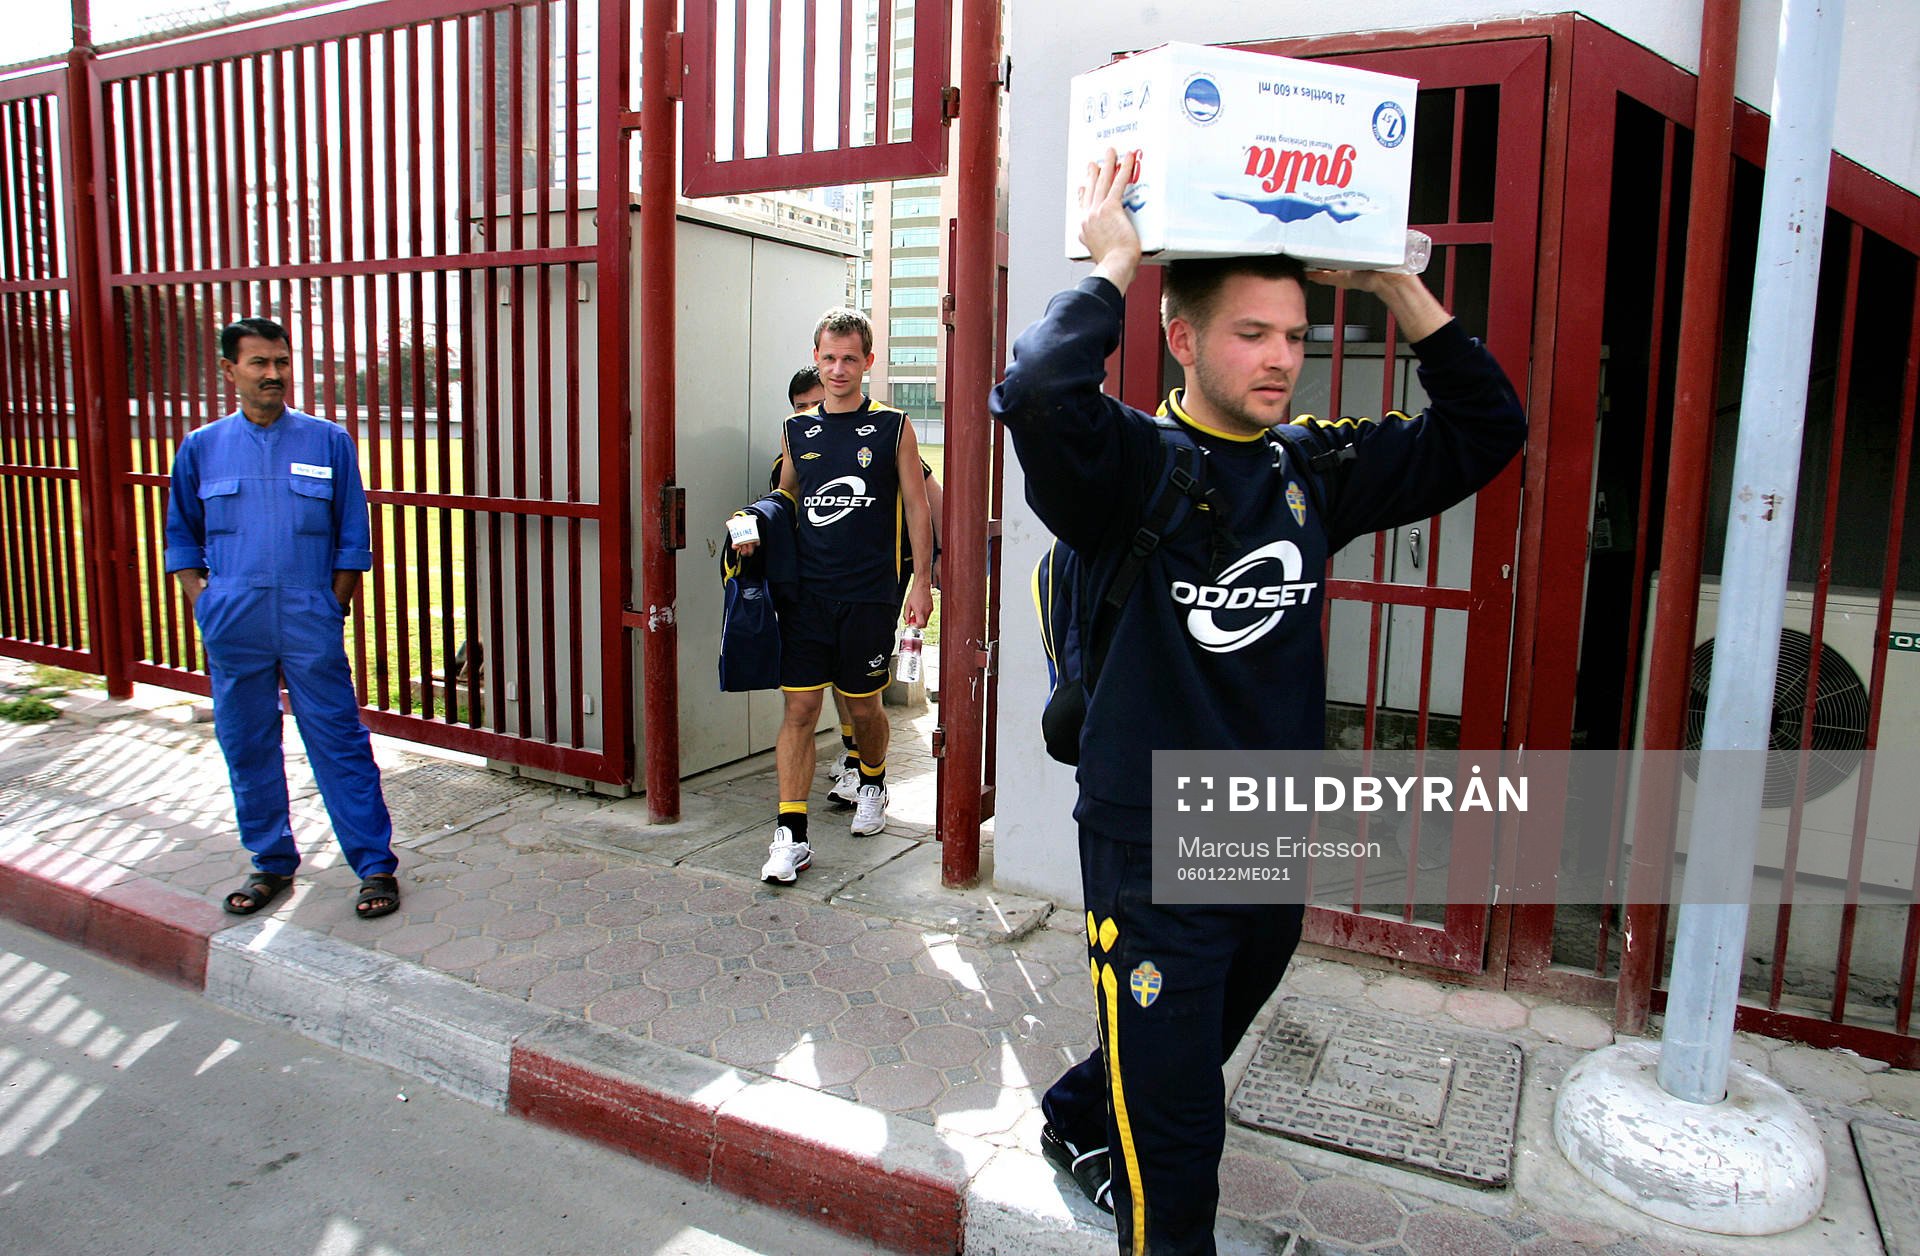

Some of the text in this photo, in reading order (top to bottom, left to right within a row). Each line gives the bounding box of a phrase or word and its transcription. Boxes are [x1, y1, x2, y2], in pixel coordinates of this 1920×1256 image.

[1258, 81, 1345, 105] 24 bottles x 600 ml
[1256, 134, 1333, 150] Natural Drinking Water
[1244, 144, 1357, 193] gulfa
[803, 495, 877, 508] ODDSET
[1171, 581, 1318, 610] ODDSET
[1316, 1088, 1433, 1122] ELECTRICAL
